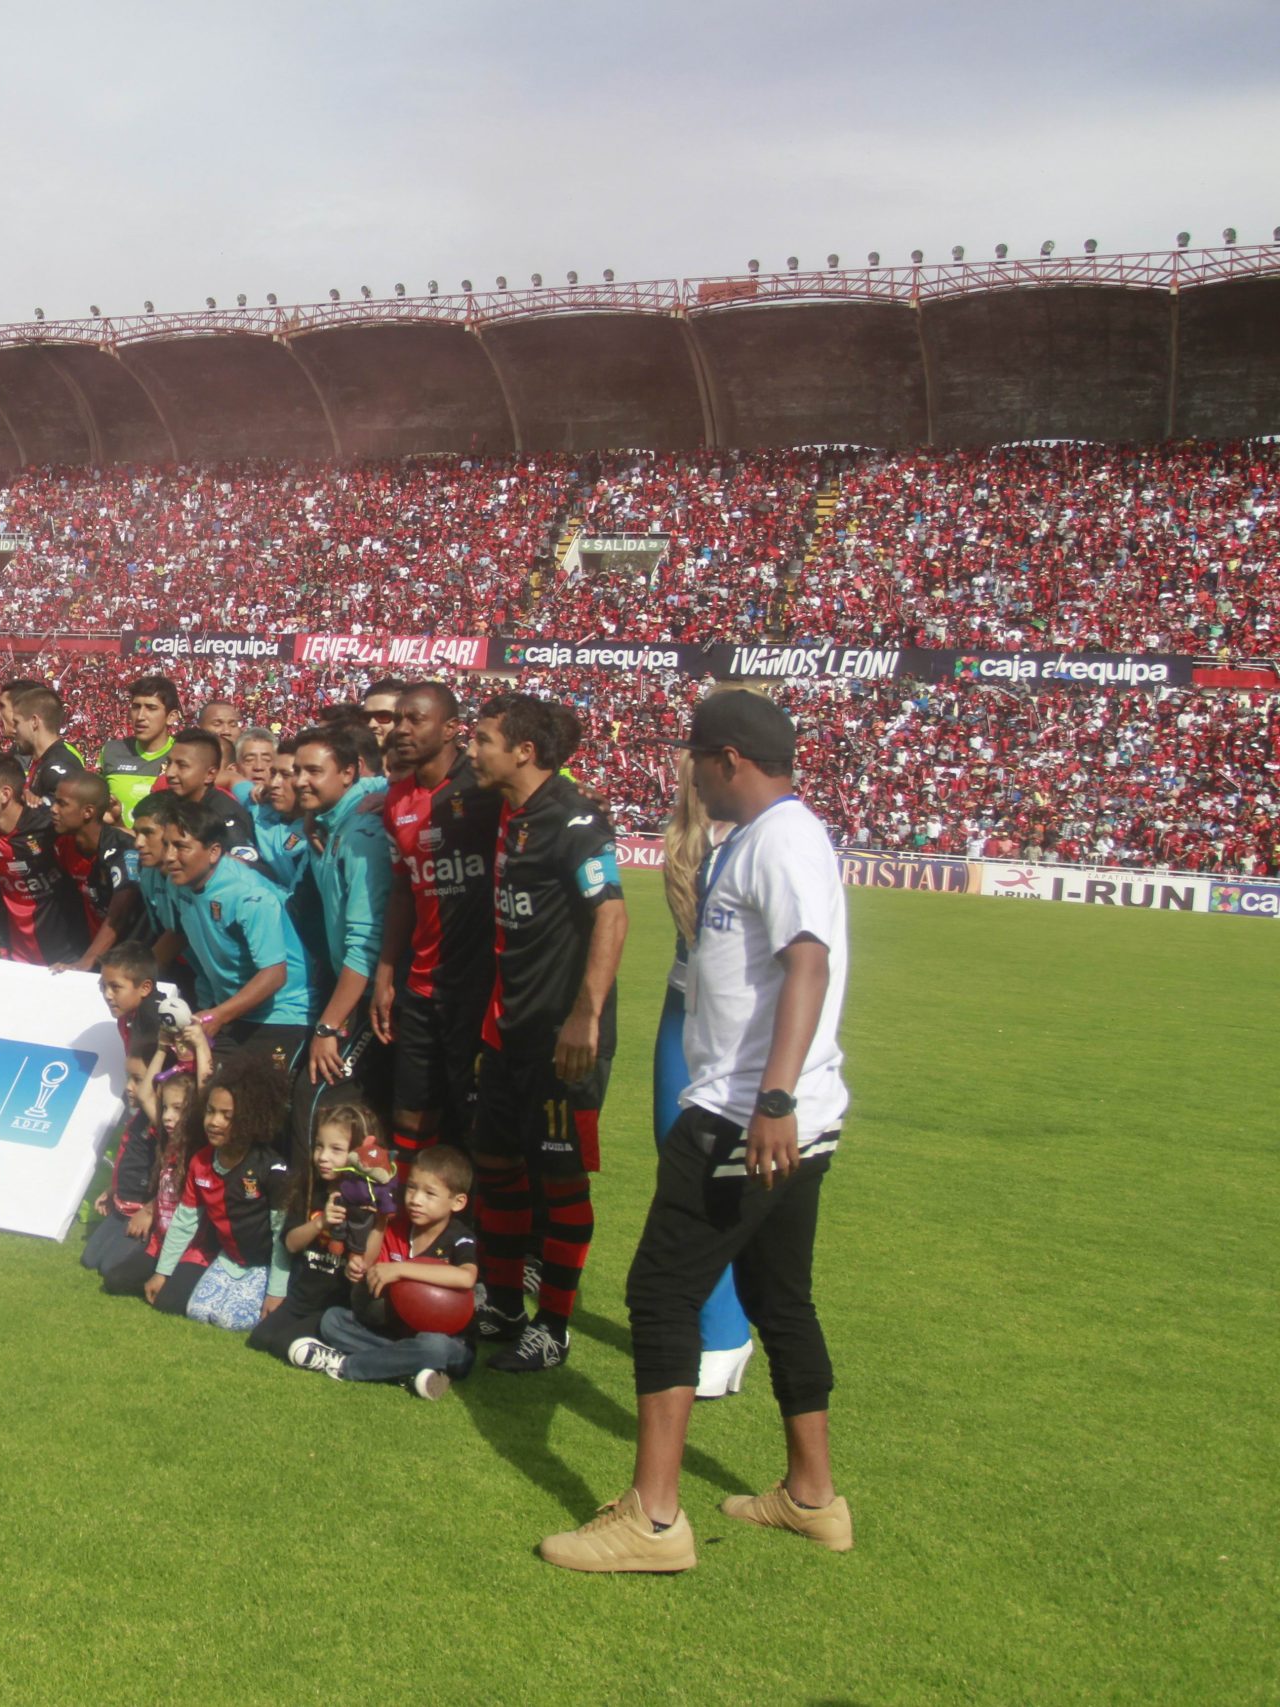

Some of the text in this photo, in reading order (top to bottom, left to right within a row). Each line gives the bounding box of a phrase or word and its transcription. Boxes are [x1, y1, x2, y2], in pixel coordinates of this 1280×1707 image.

[593, 540, 647, 551] SALIDA
[151, 634, 278, 659] caja arequipa
[388, 638, 479, 666] MELGAR!
[525, 643, 678, 669] caja arequipa
[729, 647, 823, 676] ¡VAMOS
[979, 655, 1168, 686] caja arequipa
[422, 849, 485, 884] caja
[584, 859, 605, 886] C
[1087, 872, 1150, 882] ZAPATILLAS
[1052, 877, 1195, 912] I-RUN
[543, 1099, 569, 1140] 11
